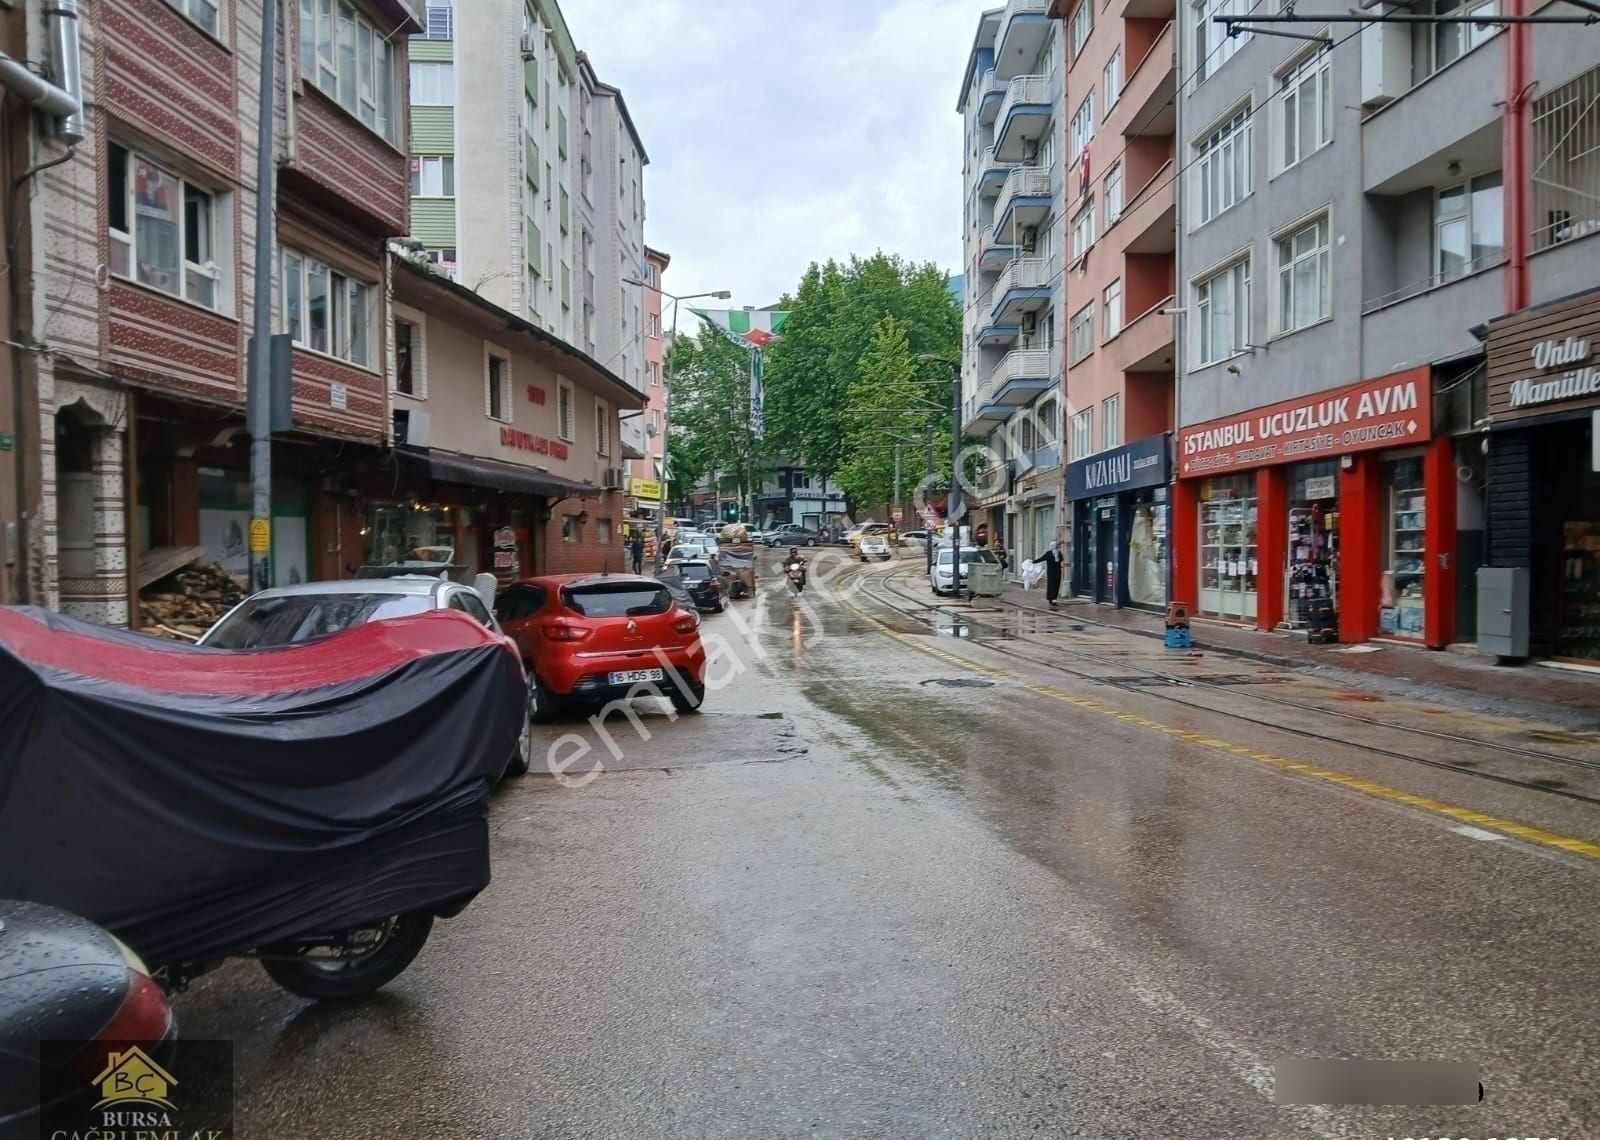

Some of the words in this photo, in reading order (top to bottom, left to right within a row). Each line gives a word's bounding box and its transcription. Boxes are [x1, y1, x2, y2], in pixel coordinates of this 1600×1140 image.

[1184, 420, 1255, 456] İSTANBUL
[1259, 397, 1350, 439] UCUZLUK
[1355, 381, 1418, 420] AVM
[1341, 420, 1406, 446] OYUNCAK
[627, 671, 647, 681] HDS
